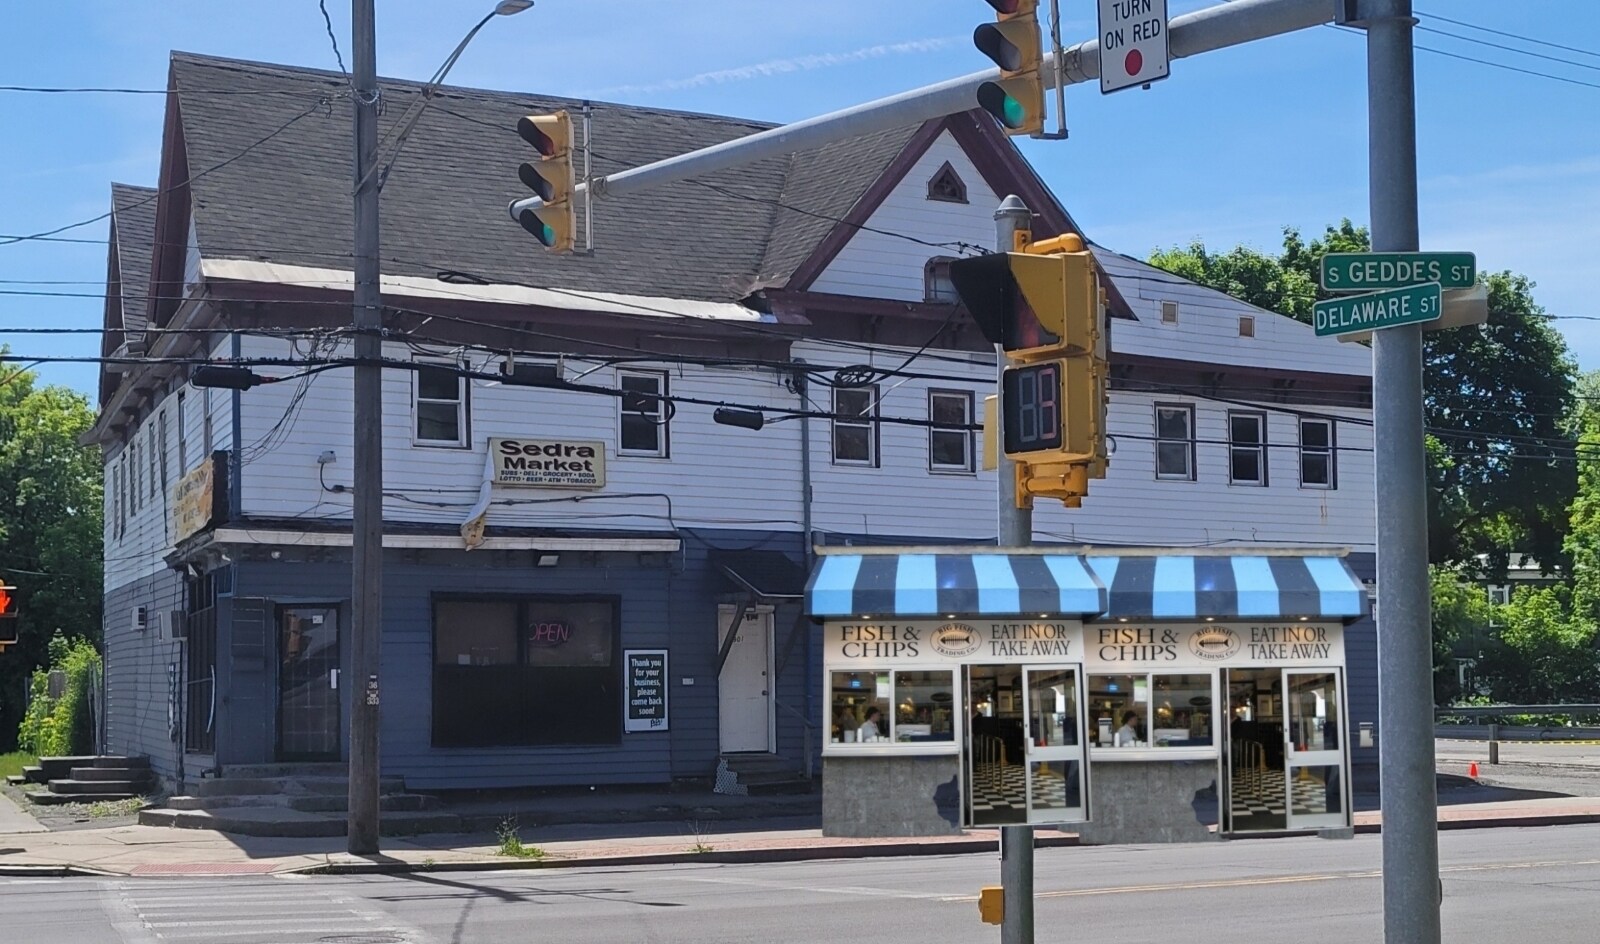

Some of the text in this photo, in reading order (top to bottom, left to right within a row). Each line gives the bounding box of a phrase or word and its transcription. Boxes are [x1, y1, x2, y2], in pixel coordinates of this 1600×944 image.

[1112, 0, 1151, 21] TURN
[1105, 18, 1160, 50] ON RED
[1328, 260, 1471, 283] S GEDDES ST
[1316, 295, 1438, 330] DELAWARE ST
[499, 440, 595, 458] Sedra
[503, 456, 593, 472] Market
[529, 623, 569, 641] OPEN
[841, 625, 922, 641] FISH &
[937, 624, 974, 634] BIG FISH
[991, 624, 1067, 640] EAT IN OR
[1098, 628, 1180, 644] FISH &
[1195, 627, 1233, 638] BIG FISH
[1250, 627, 1328, 643] EAT IN OR
[842, 641, 919, 658] CHIPS
[936, 646, 966, 656] TRADING
[988, 640, 1071, 656] TAKE AWAY
[1099, 645, 1177, 661] CHIPS
[1195, 650, 1224, 659] TRADING
[1248, 643, 1331, 659] TAKE AWAY
[631, 658, 661, 668] Thank you
[635, 668, 660, 678] for your
[634, 678, 661, 686] business,
[637, 688, 656, 697] please
[648, 697, 662, 705] back
[639, 707, 655, 715] soon!
